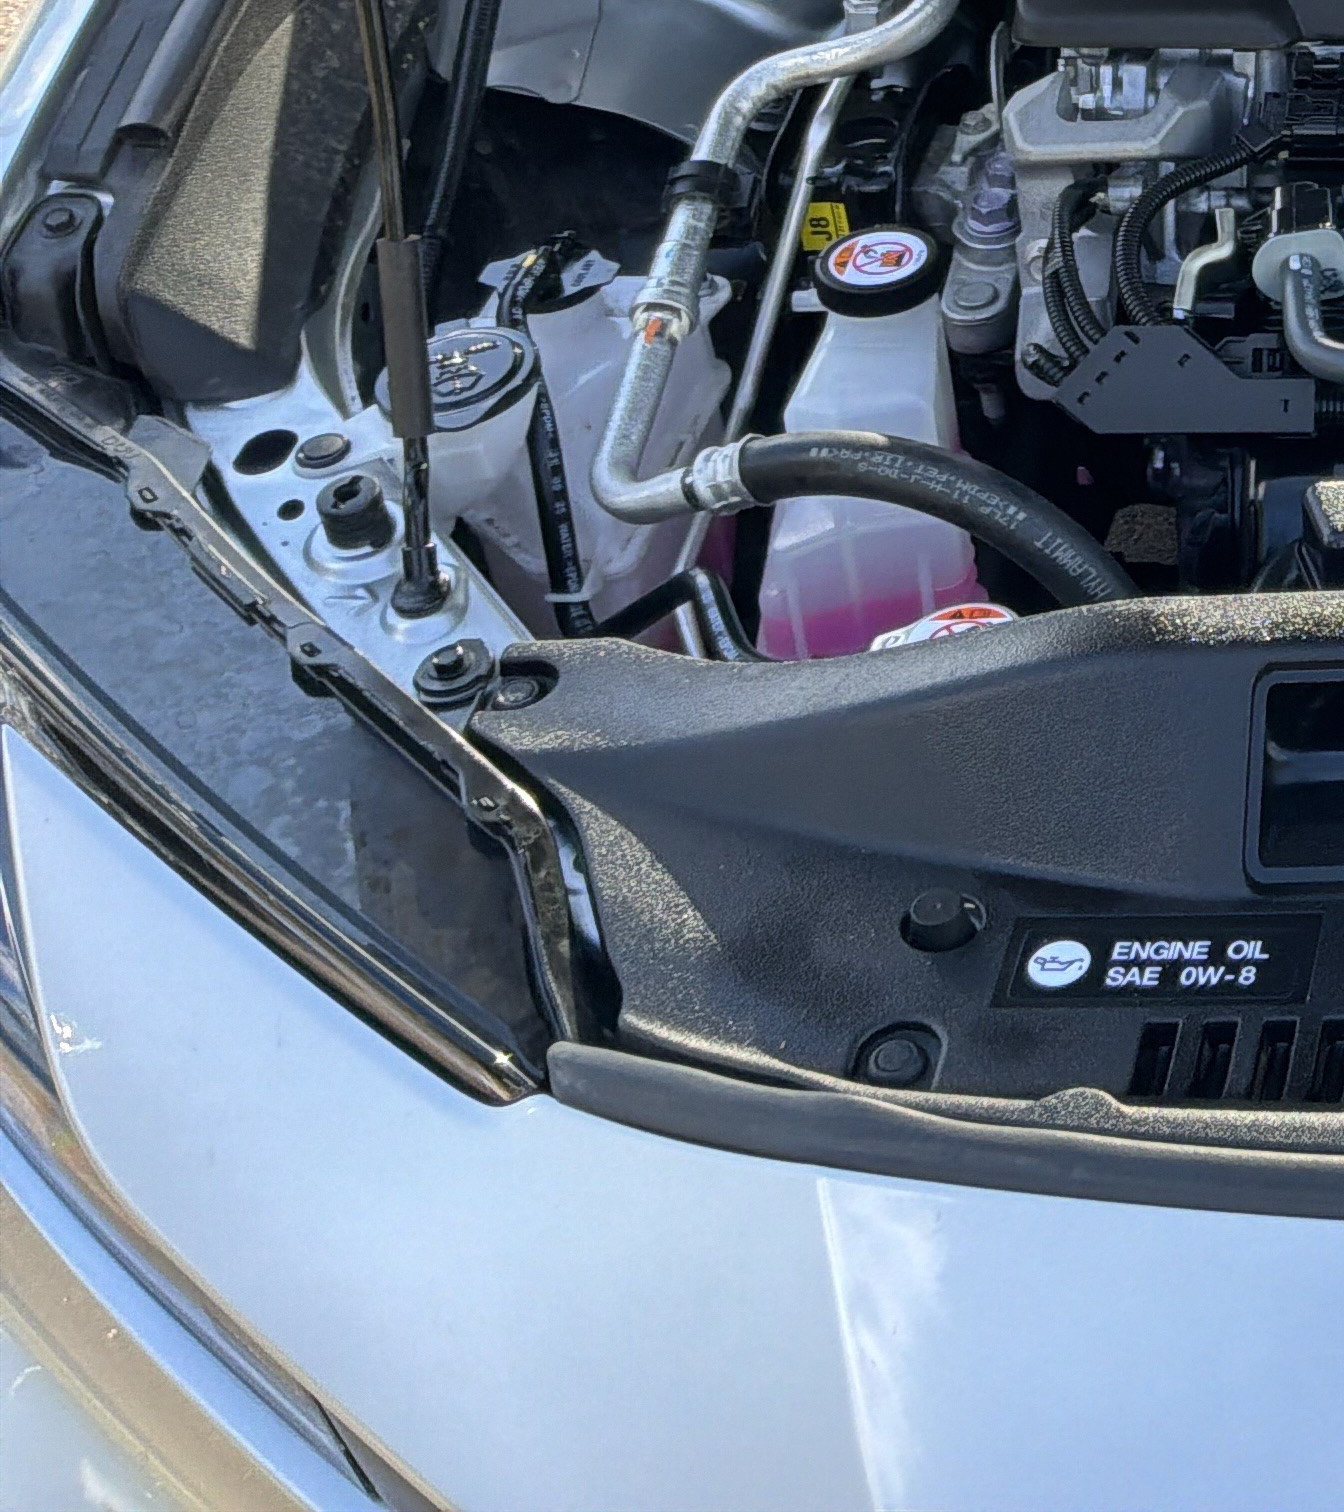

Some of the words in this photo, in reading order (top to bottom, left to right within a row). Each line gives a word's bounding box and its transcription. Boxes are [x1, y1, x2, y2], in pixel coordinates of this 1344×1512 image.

[1034, 531, 1113, 600] HYLAMMIT
[1110, 939, 1212, 961] ENGINE
[1226, 939, 1270, 961] OIL
[1104, 966, 1162, 987] SAE
[1179, 966, 1257, 987] 0W-8
